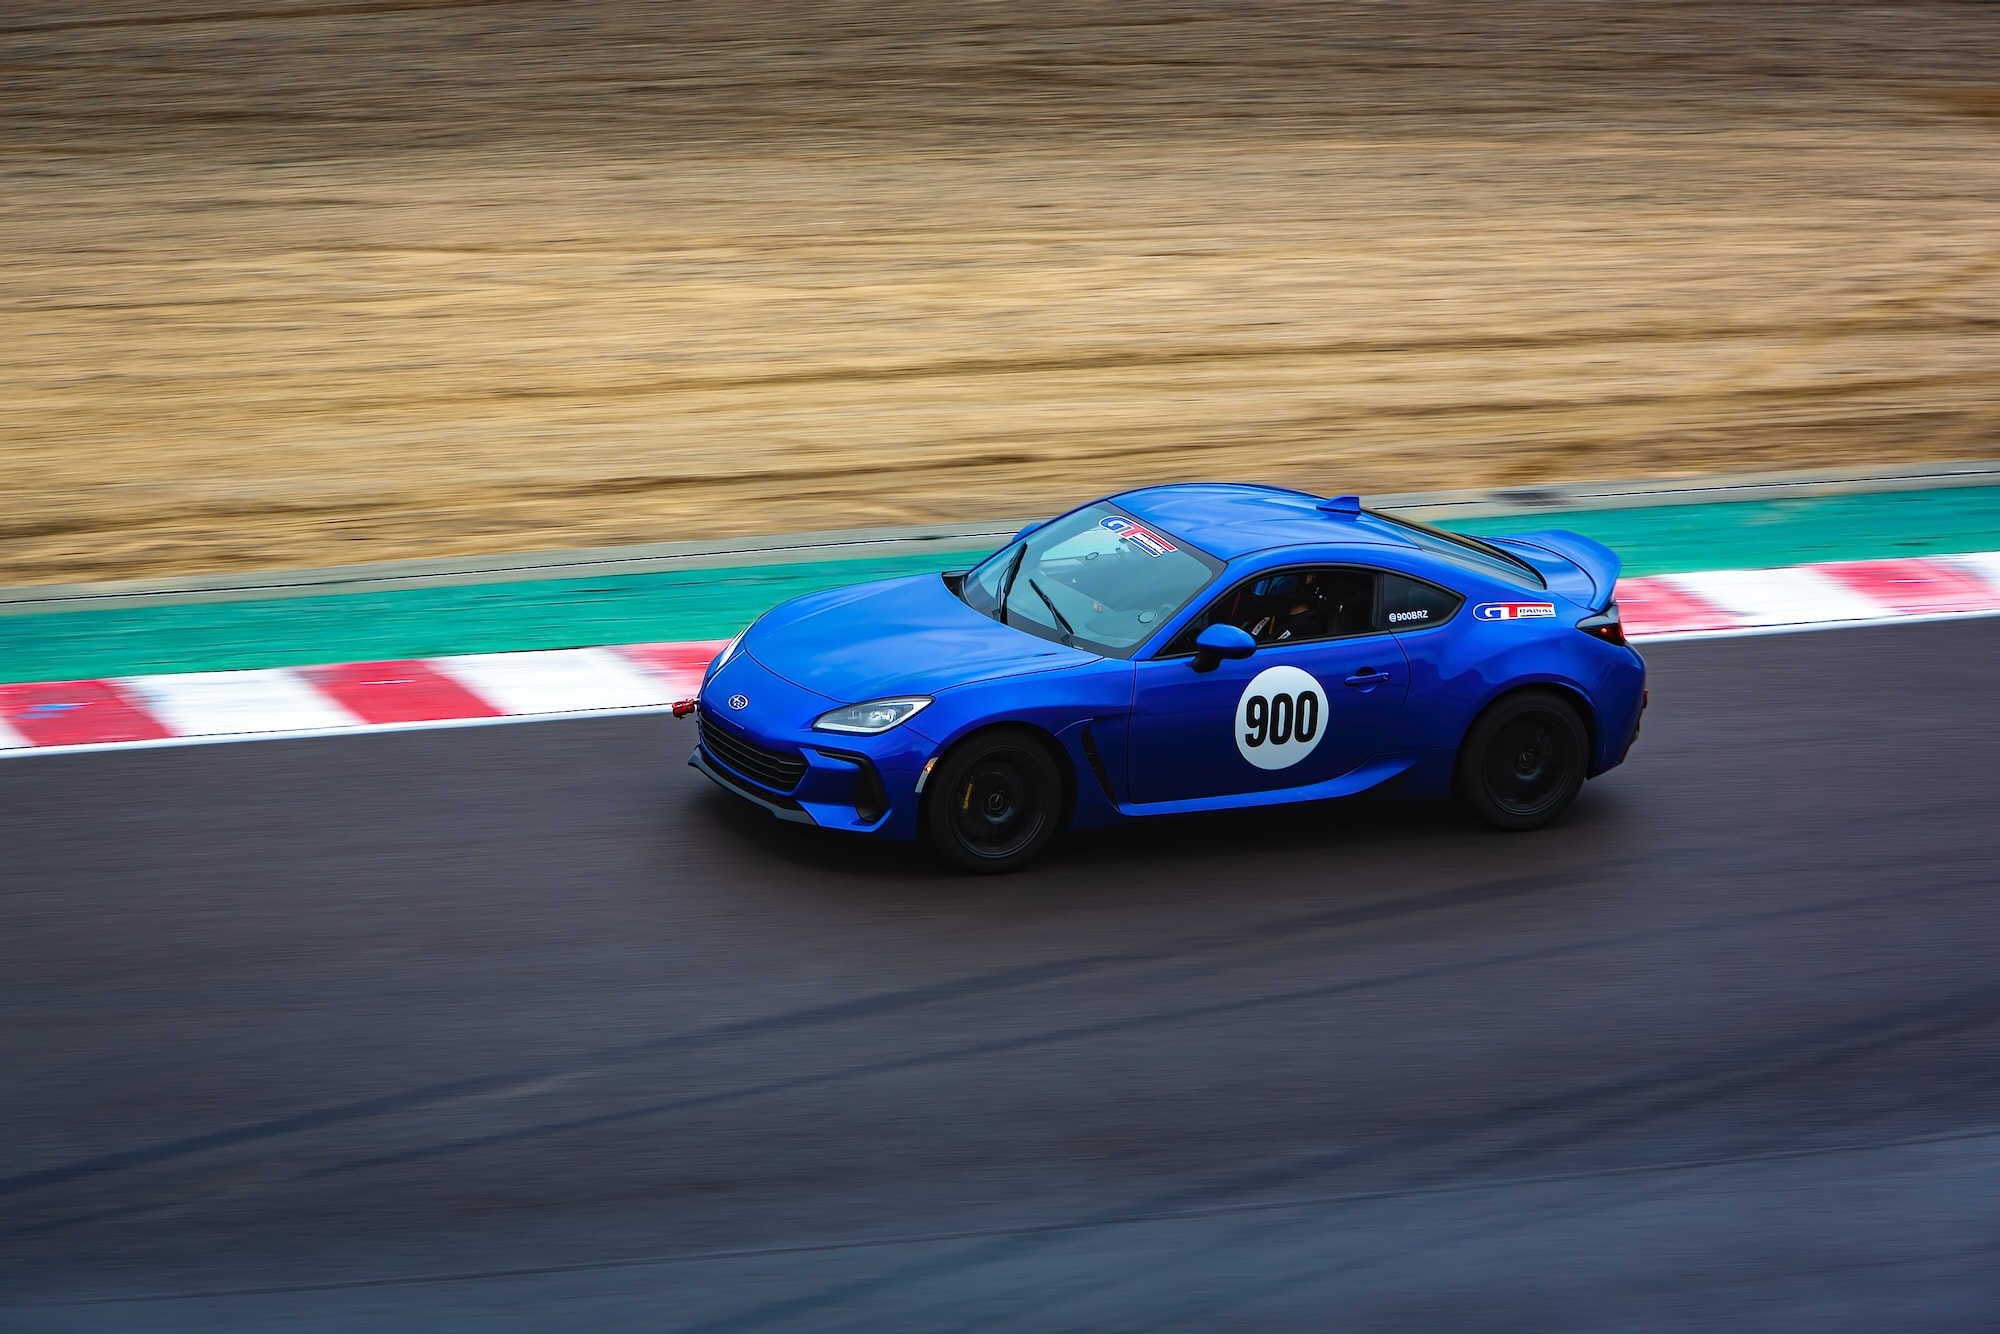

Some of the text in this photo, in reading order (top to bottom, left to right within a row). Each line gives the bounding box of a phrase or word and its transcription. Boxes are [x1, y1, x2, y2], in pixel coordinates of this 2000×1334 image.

[1389, 610, 1428, 622] @900BRZ
[1473, 603, 1518, 618] GT
[1245, 691, 1318, 747] 900
